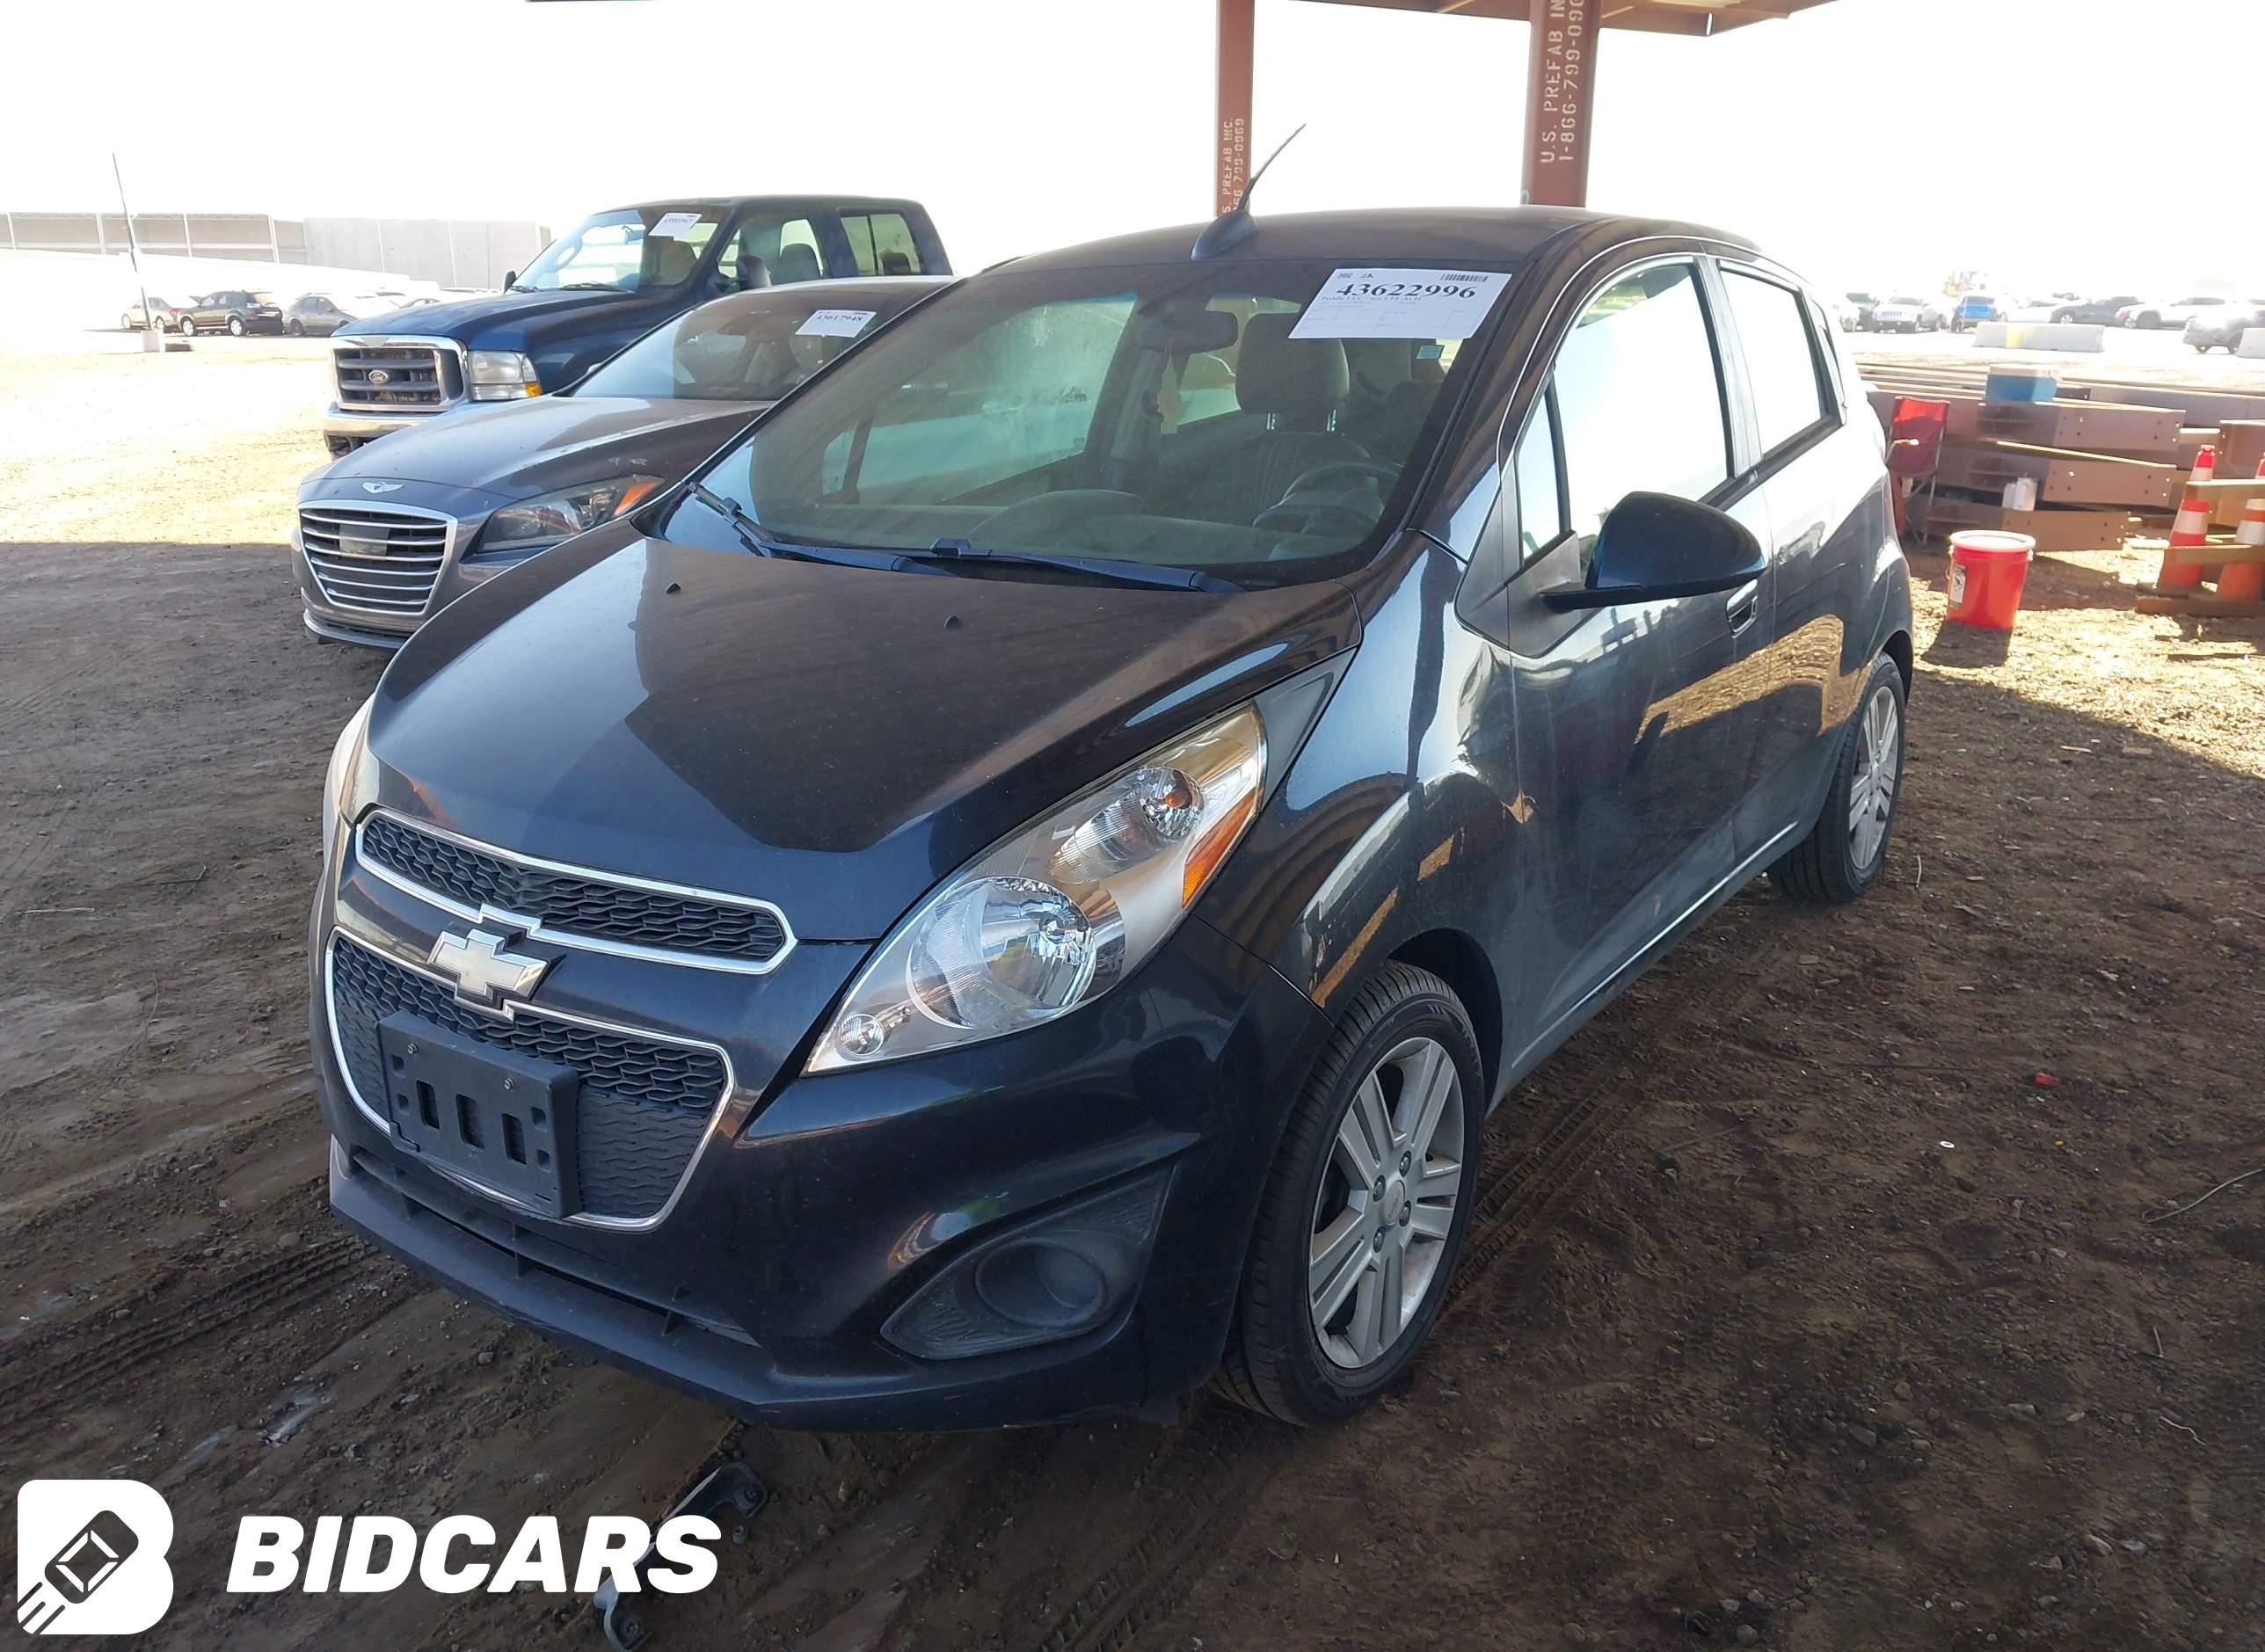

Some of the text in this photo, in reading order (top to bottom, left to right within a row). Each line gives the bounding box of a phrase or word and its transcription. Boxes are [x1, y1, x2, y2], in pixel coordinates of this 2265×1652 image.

[1543, 29, 1563, 112] PREFAB
[1540, 124, 1558, 164] U.S.
[1222, 147, 1233, 195] PREFAB
[1336, 283, 1477, 299] 43622996
